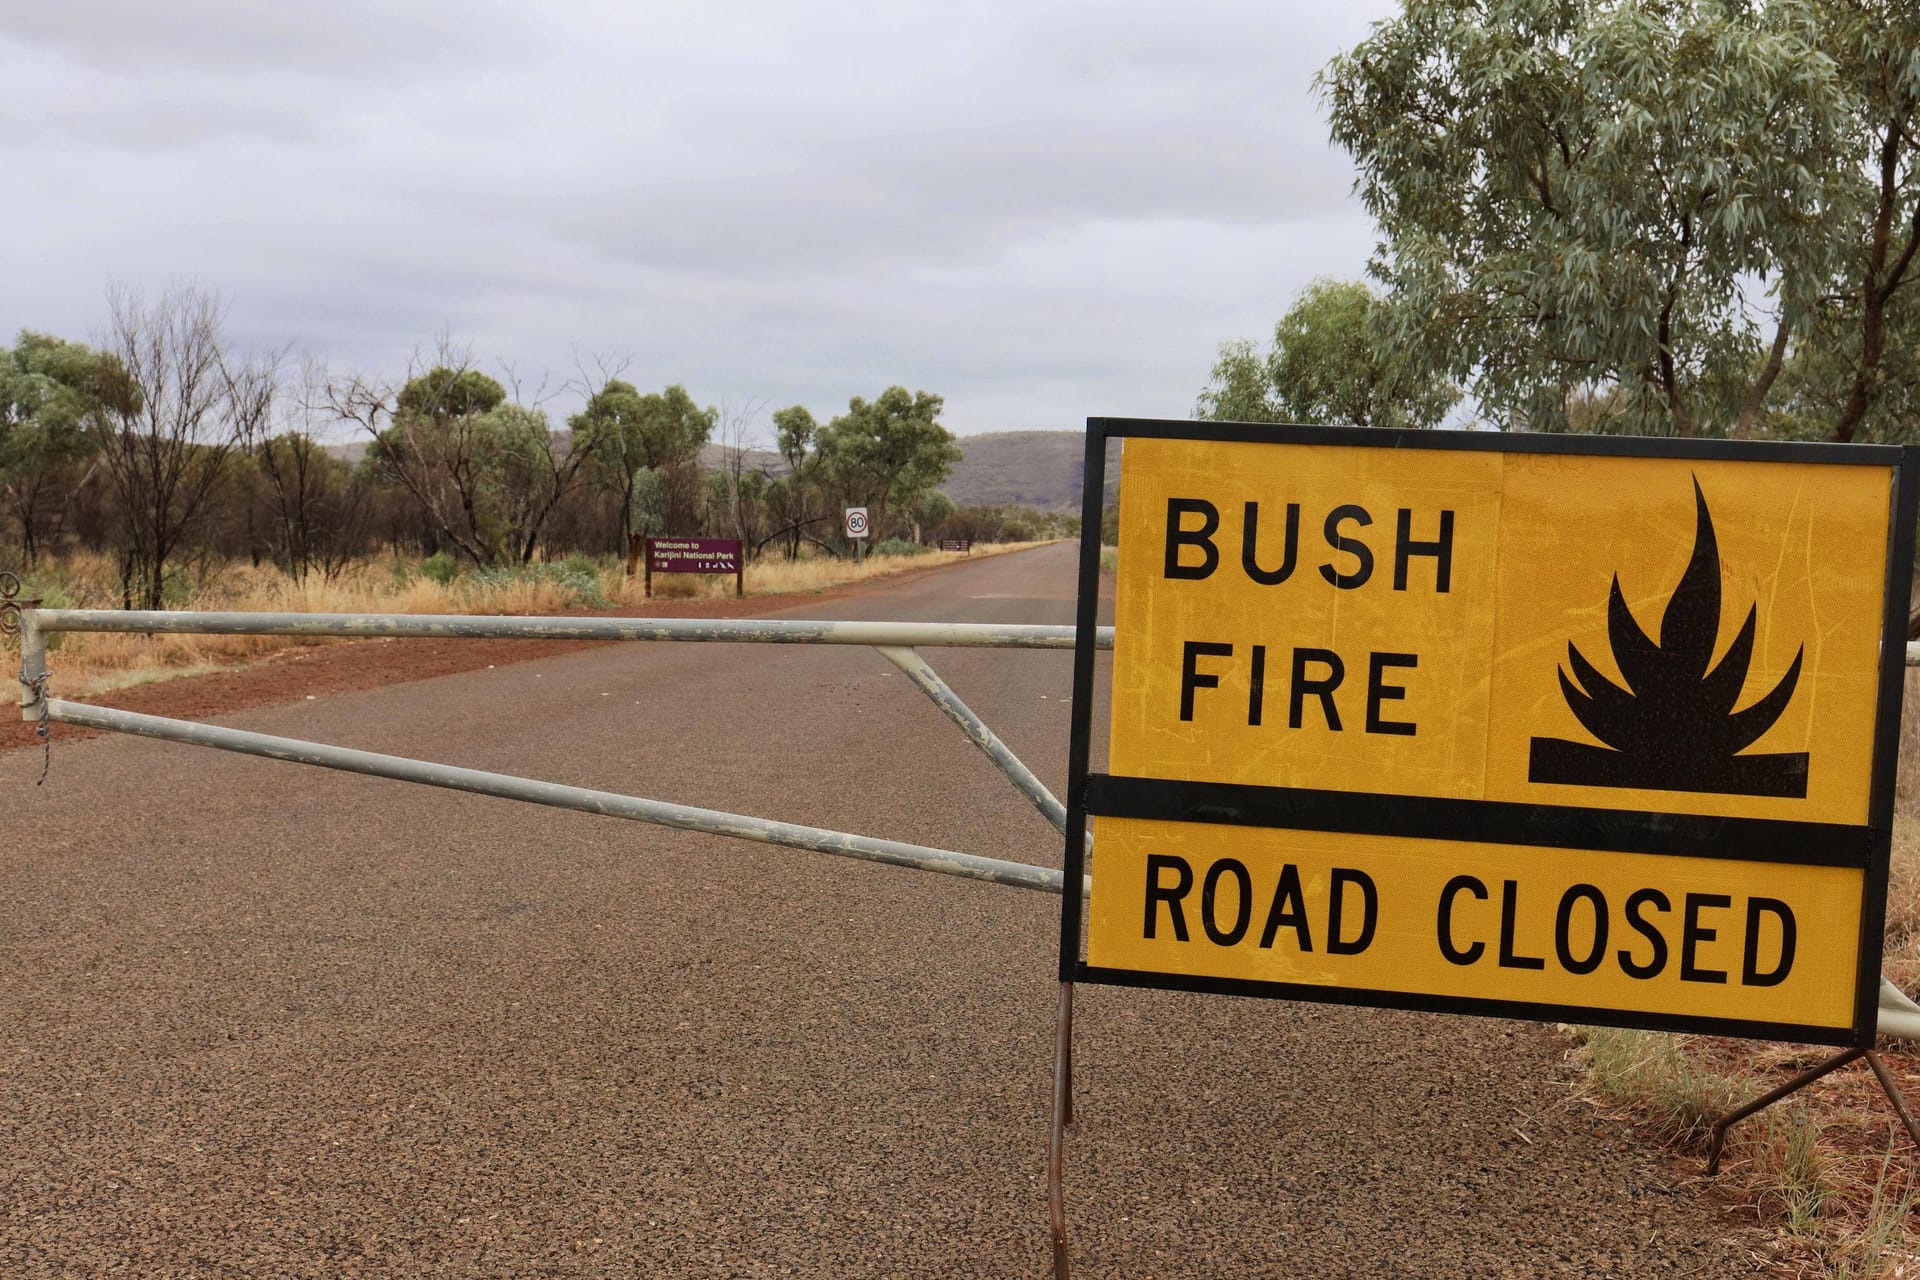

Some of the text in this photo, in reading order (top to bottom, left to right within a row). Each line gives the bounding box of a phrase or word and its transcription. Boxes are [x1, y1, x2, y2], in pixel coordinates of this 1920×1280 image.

[654, 551, 734, 560] Karijini National Park
[850, 517, 864, 528] 80
[1163, 497, 1455, 594] BUSH
[1179, 640, 1419, 737] FIRE
[1142, 853, 1797, 988] ROAD CLOSED
